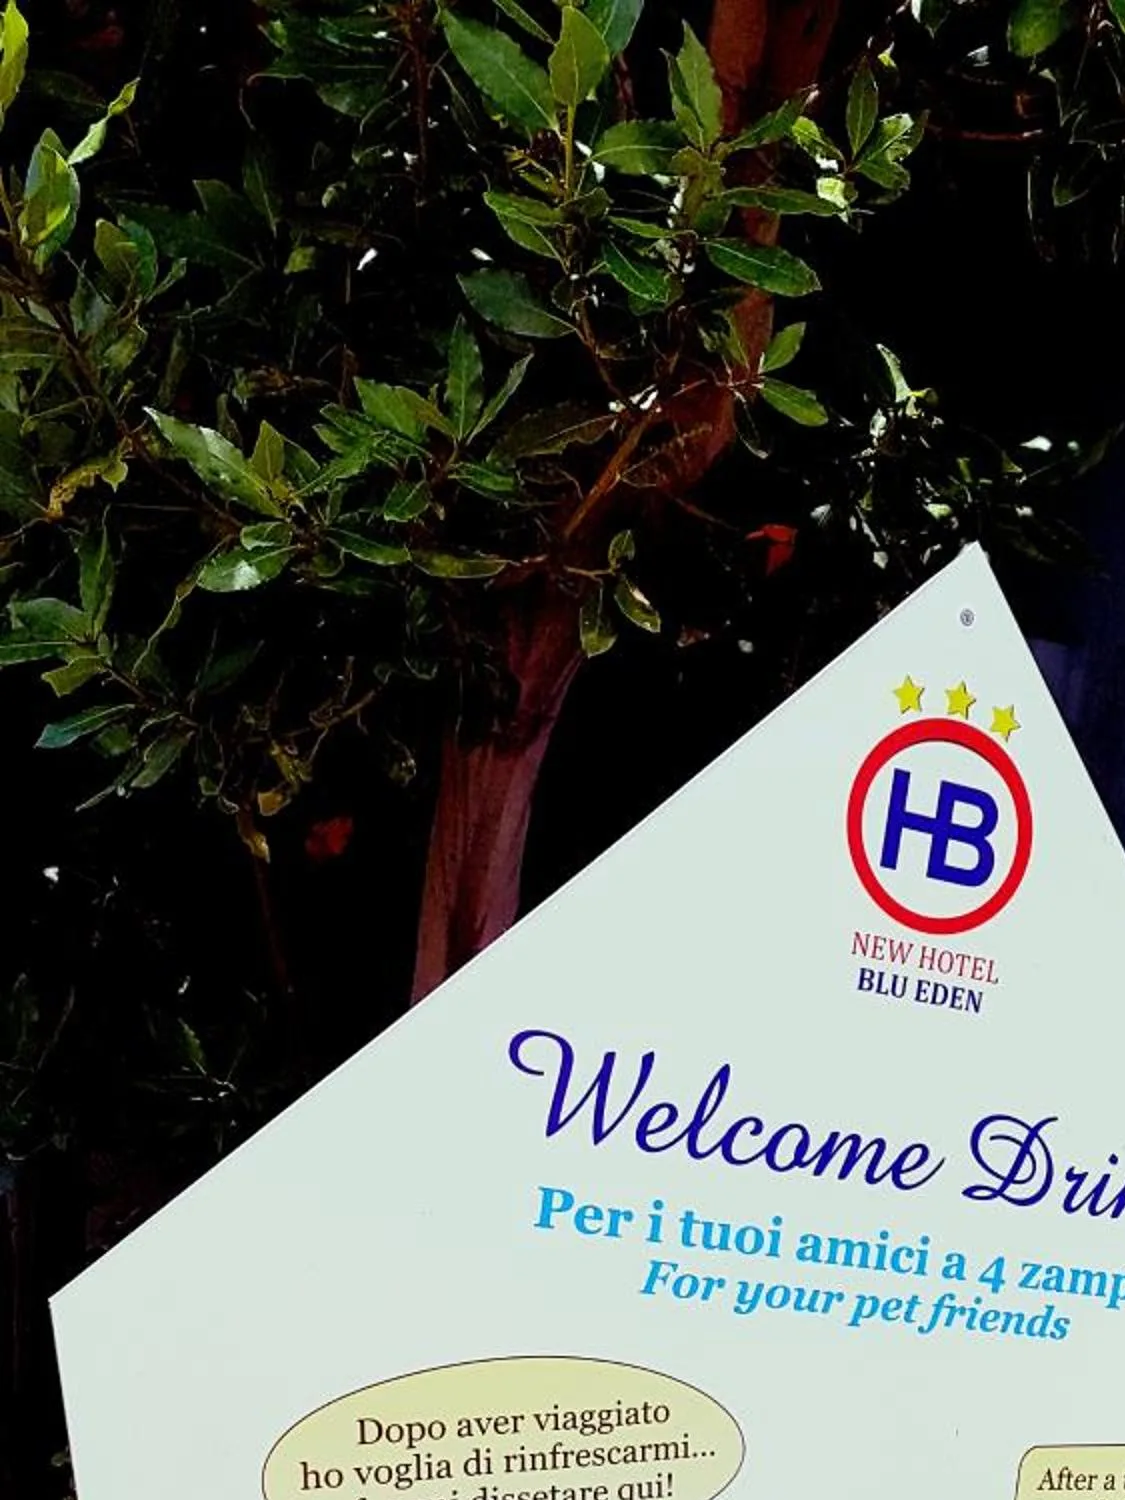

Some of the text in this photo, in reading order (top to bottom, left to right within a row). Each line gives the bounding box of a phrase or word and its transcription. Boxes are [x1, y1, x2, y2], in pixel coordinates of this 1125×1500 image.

[880, 768, 998, 887] HB
[851, 932, 999, 984] NEW HOTEL
[857, 967, 983, 1014] BLU EDEN
[509, 1029, 945, 1190] Welcome
[533, 1186, 633, 1242] Per
[646, 1200, 664, 1243] i
[680, 1209, 782, 1258] tuoi
[797, 1229, 928, 1276] amici
[943, 1252, 966, 1281] a
[979, 1257, 1006, 1292] 4
[639, 1260, 1071, 1340] For your pet friends
[357, 1400, 670, 1448] Dopo aver viaggiato
[300, 1434, 715, 1491] ho voglia di rinfrescarmi...
[1036, 1467, 1098, 1491] After
[1103, 1475, 1115, 1491] a
